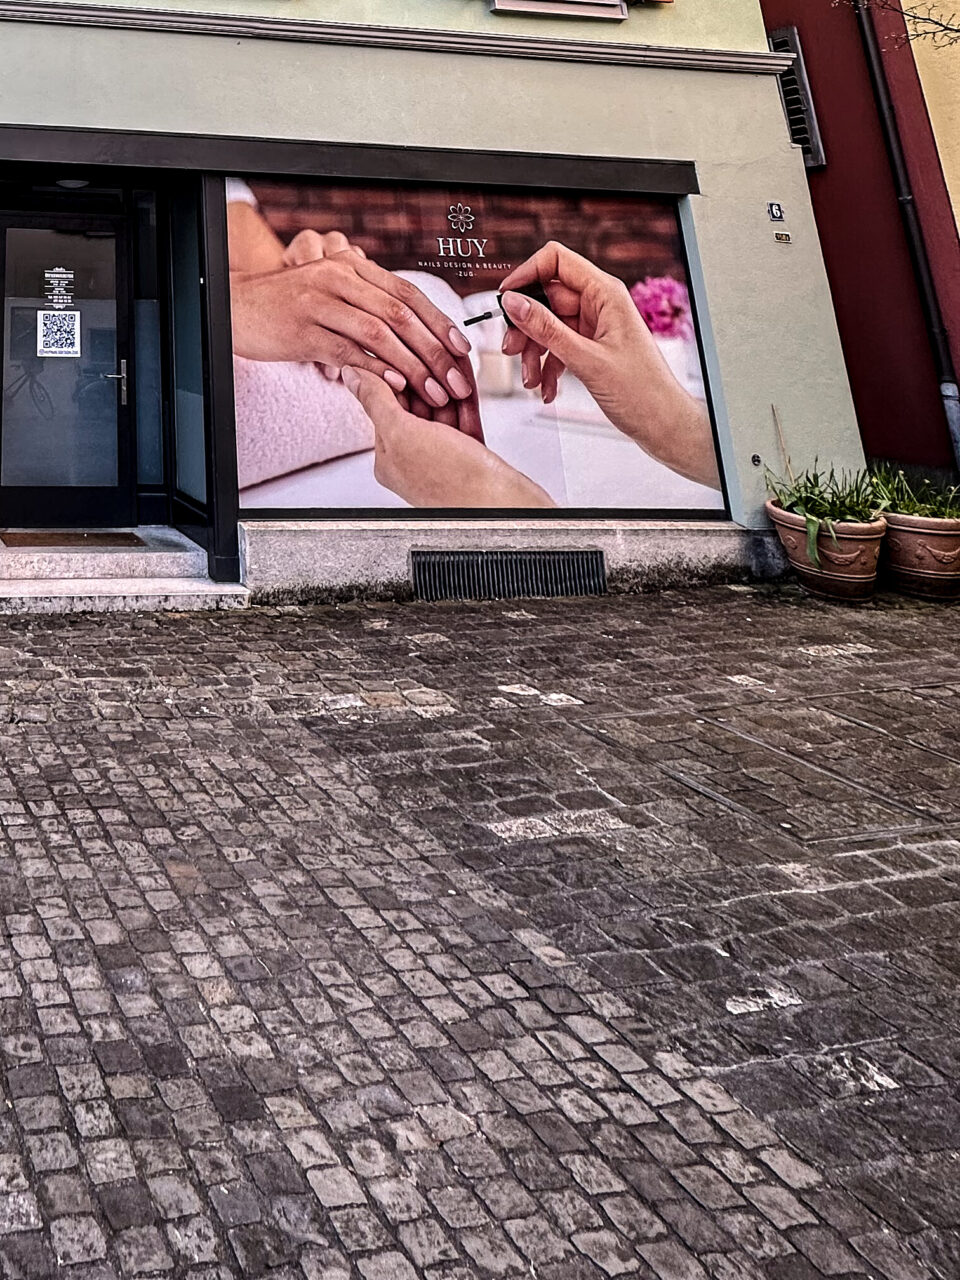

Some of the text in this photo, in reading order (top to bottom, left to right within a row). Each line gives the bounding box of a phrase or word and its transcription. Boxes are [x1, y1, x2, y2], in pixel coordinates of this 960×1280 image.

[772, 204, 780, 217] 6
[436, 237, 488, 258] HUY
[444, 261, 473, 269] DESIGN
